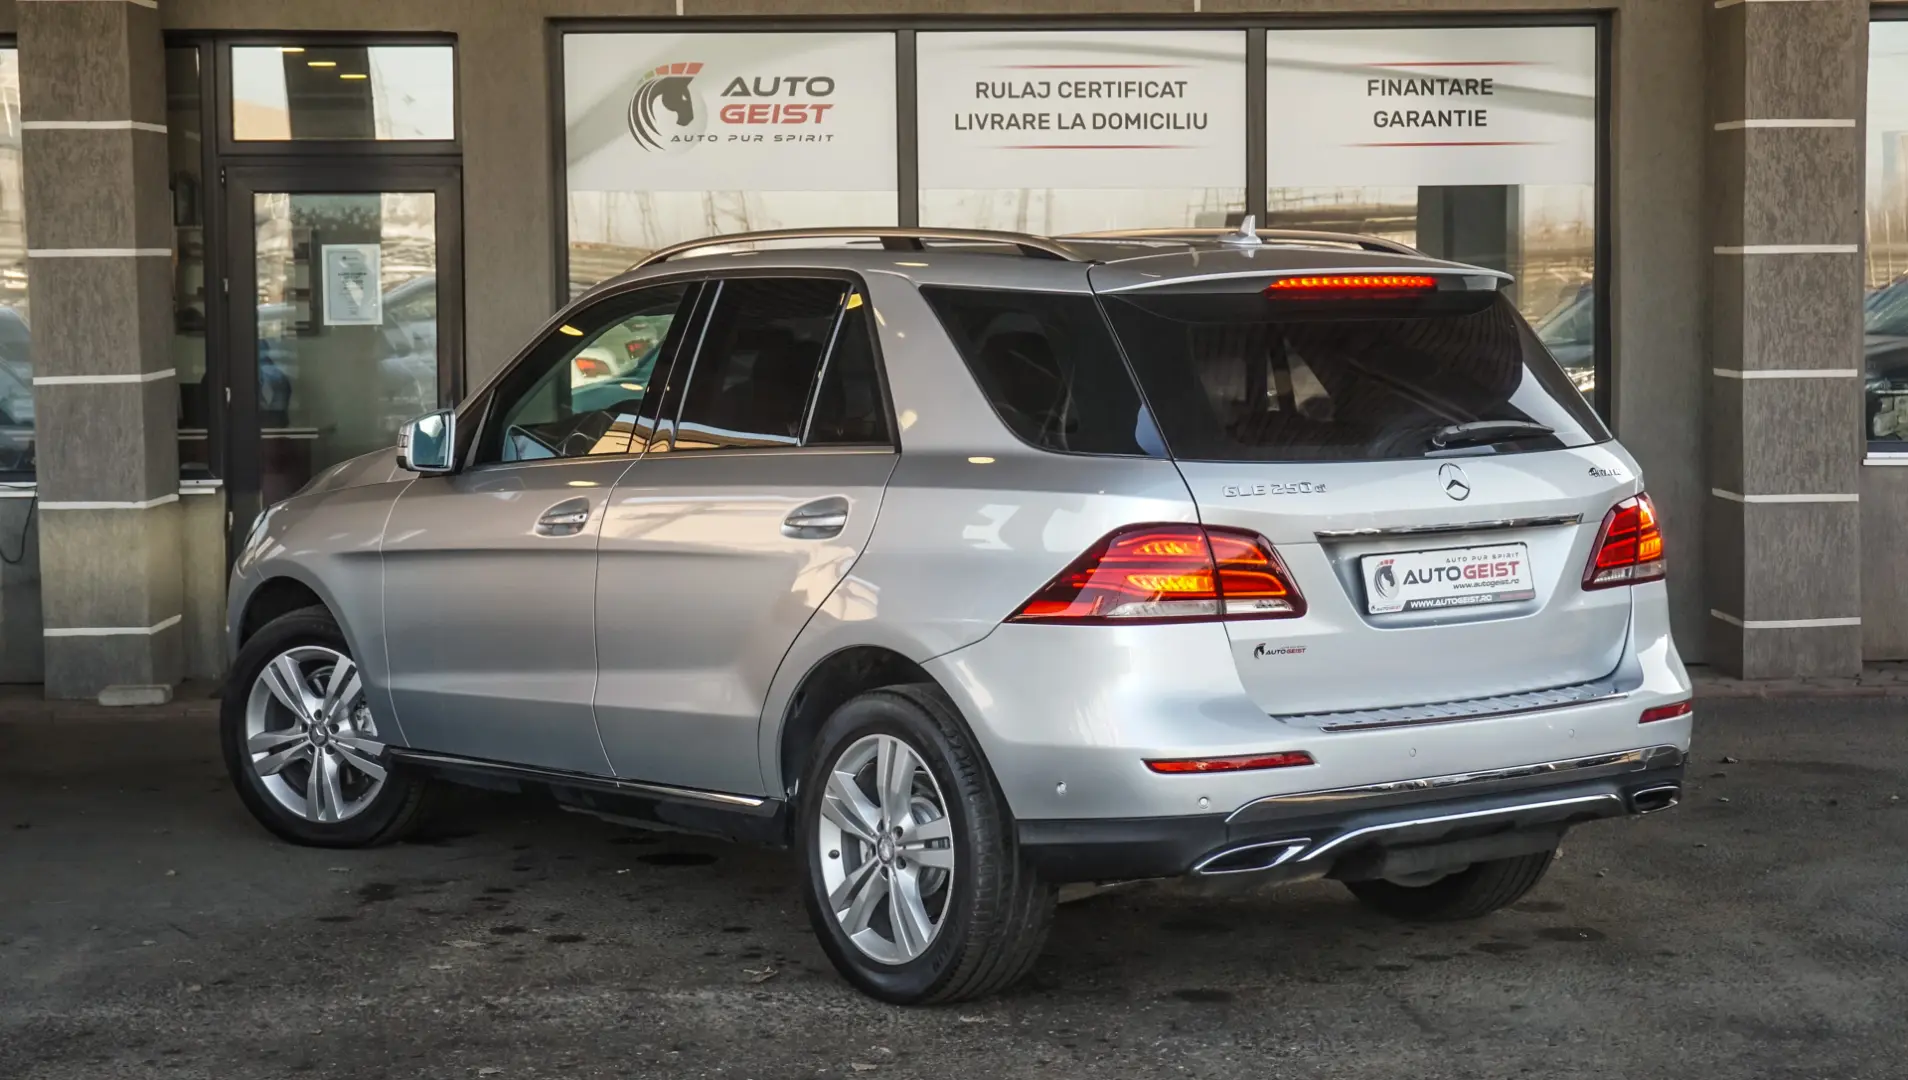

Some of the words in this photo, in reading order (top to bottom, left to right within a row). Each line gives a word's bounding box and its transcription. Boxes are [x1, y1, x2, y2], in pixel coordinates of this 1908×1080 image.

[720, 76, 835, 97] AUTO
[975, 81, 1051, 99] RULAJ
[1057, 81, 1188, 98] CERTIFICAT
[1367, 78, 1493, 96] FINANTARE
[719, 103, 834, 124] GEIST
[954, 112, 1051, 131] LIVRARE
[1057, 112, 1086, 130] LA
[1092, 112, 1208, 130] DOMICILIU
[1373, 110, 1487, 127] GARANTIE
[670, 134, 718, 142] AUTO
[727, 134, 764, 142] PUR
[773, 134, 835, 142] SPIRIT
[1222, 484, 1266, 498] GLE
[1446, 556, 1468, 564] AUTO
[1491, 552, 1519, 560] SPIRIT
[1403, 560, 1520, 585] AUTOGEIST
[1453, 578, 1520, 590] www.autogeist.ro
[1410, 594, 1493, 609] WWW.AUTOGEIST.RO
[1265, 647, 1307, 656] AUTOGEIST
